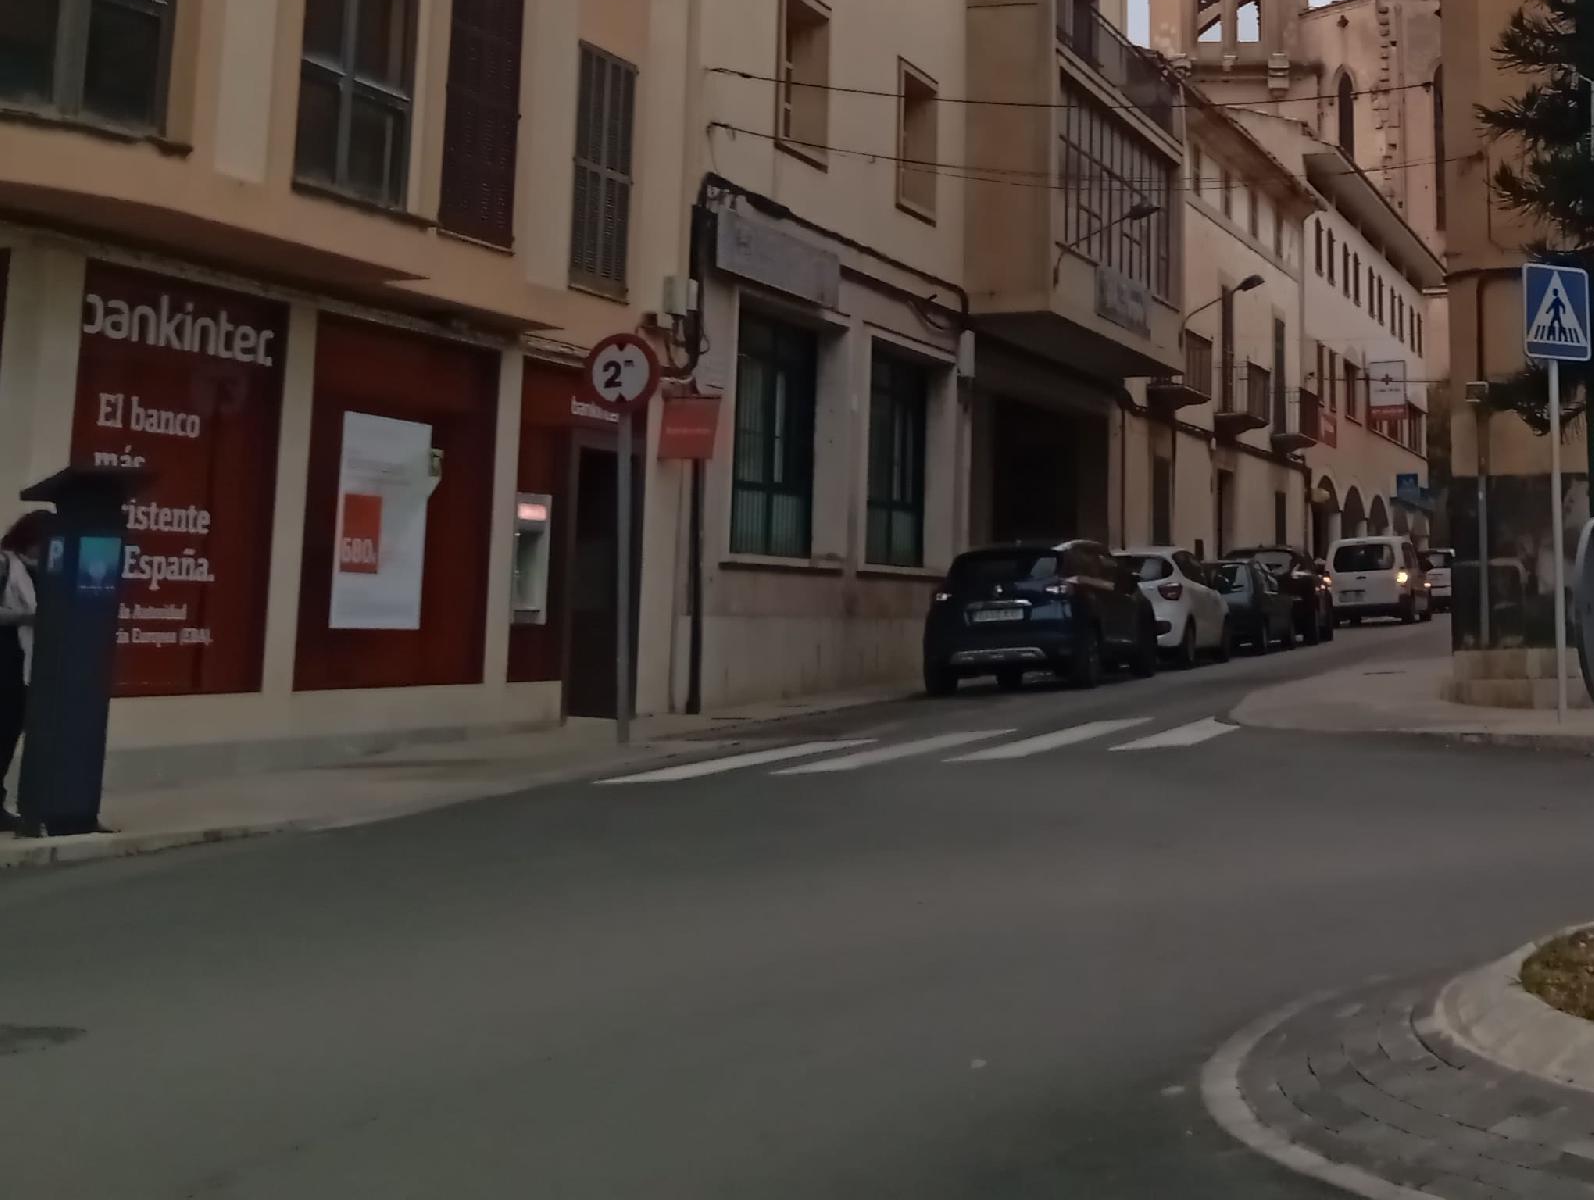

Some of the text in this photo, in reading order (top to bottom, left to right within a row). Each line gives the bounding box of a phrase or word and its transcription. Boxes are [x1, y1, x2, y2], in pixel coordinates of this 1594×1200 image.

[97, 392, 200, 438] El banco
[121, 498, 211, 534] istente
[121, 545, 215, 590] España.
